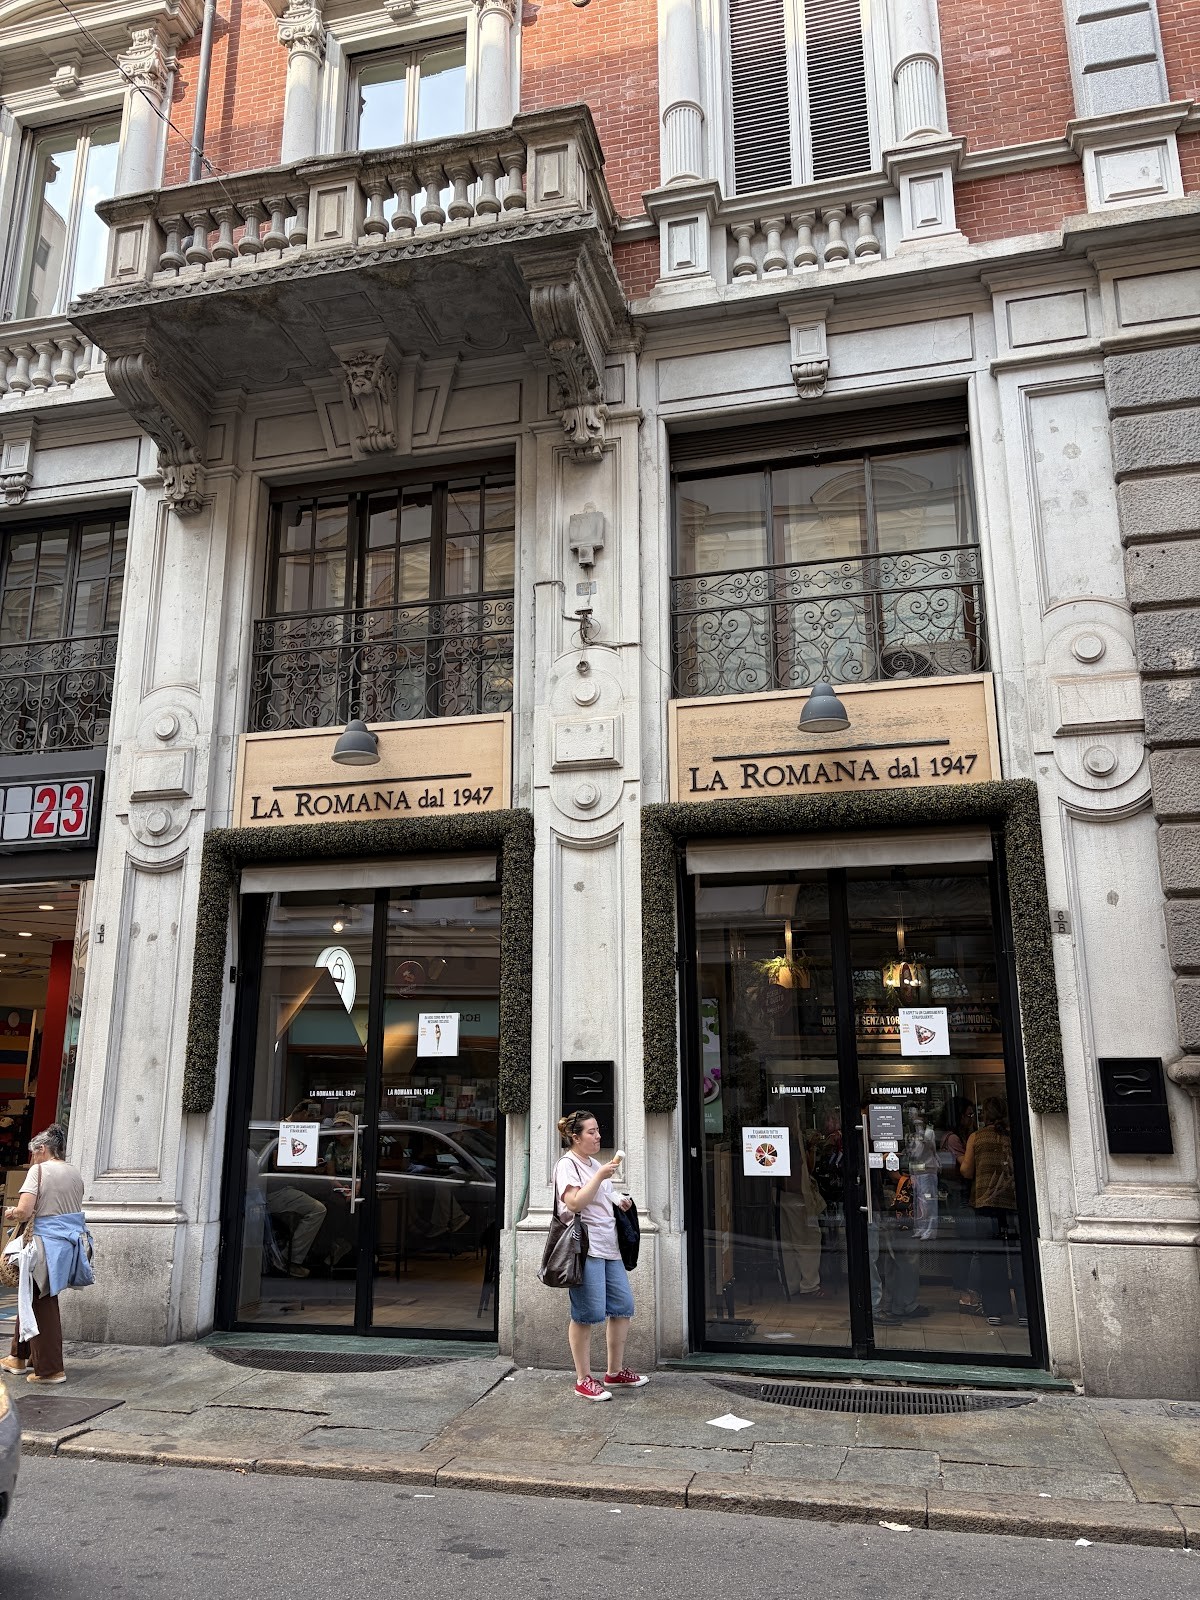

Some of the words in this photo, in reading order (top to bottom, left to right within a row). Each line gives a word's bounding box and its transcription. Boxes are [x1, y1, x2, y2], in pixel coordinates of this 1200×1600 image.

[689, 767, 728, 792] LA
[740, 760, 880, 789] ROMANA
[887, 756, 920, 779] dal
[930, 754, 978, 777] 1947
[250, 796, 284, 820] LA
[294, 790, 412, 816] ROMANA
[418, 787, 445, 808] dal
[453, 786, 494, 806] 1947
[33, 785, 84, 834] 23
[1058, 910, 1064, 920] 6
[1059, 923, 1066, 932] B
[861, 1016, 885, 1026] SENZA
[886, 1015, 901, 1026] TOR
[387, 1088, 394, 1096] LA
[394, 1088, 413, 1096] ROMANA
[771, 1086, 779, 1094] LA
[779, 1086, 801, 1094] ROMANA
[870, 1087, 878, 1095] LA
[878, 1087, 901, 1095] ROMANA
[914, 1086, 927, 1094] 1947
